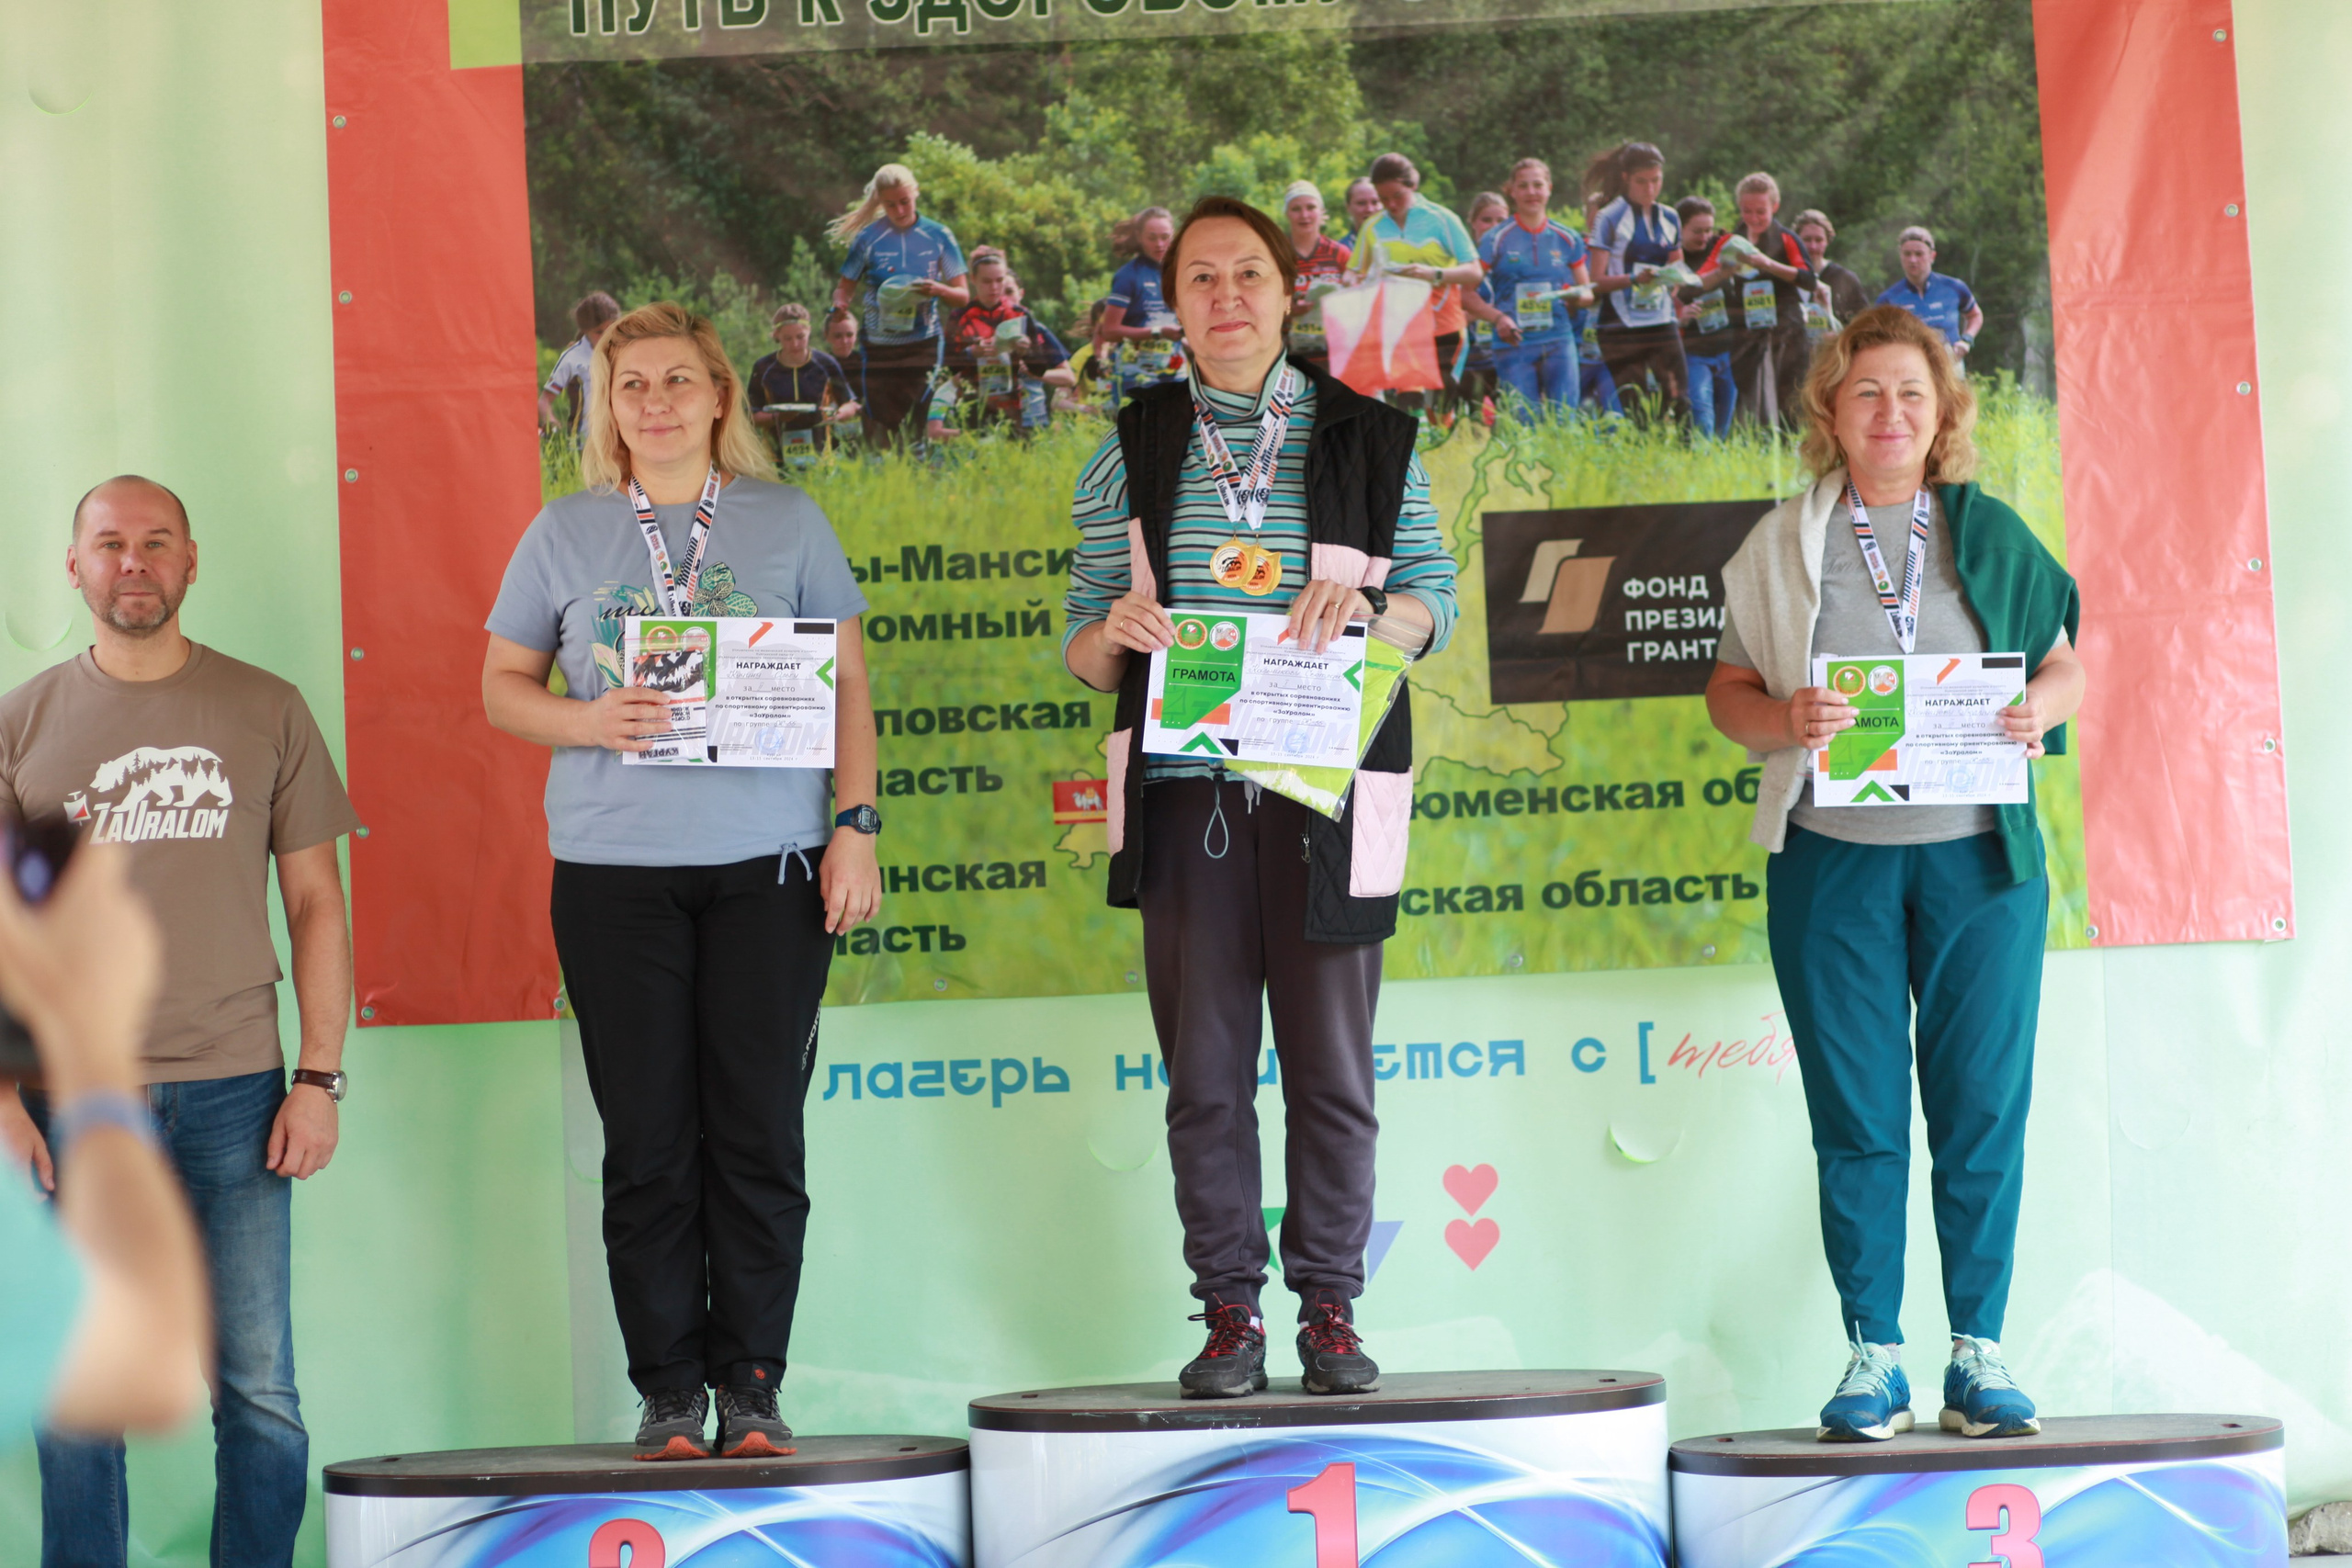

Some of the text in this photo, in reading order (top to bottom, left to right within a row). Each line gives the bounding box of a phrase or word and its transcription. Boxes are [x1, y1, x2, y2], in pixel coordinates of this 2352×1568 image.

[1623, 574, 1709, 601] ФОНД
[860, 599, 1051, 643] омный
[1627, 637, 1717, 663] ГРАНТ
[736, 661, 801, 671] НАГРАЖДАЕТ
[1172, 668, 1236, 682] ГРАМОТА
[1263, 658, 1329, 670] НАГРАЖДАЕТ
[1925, 698, 1991, 706] НАГРАЖДАЕТ
[1852, 716, 1899, 728] АМОТА
[1542, 869, 1760, 910] область
[1286, 1461, 1360, 1568] 1
[1965, 1483, 2045, 1568] 3
